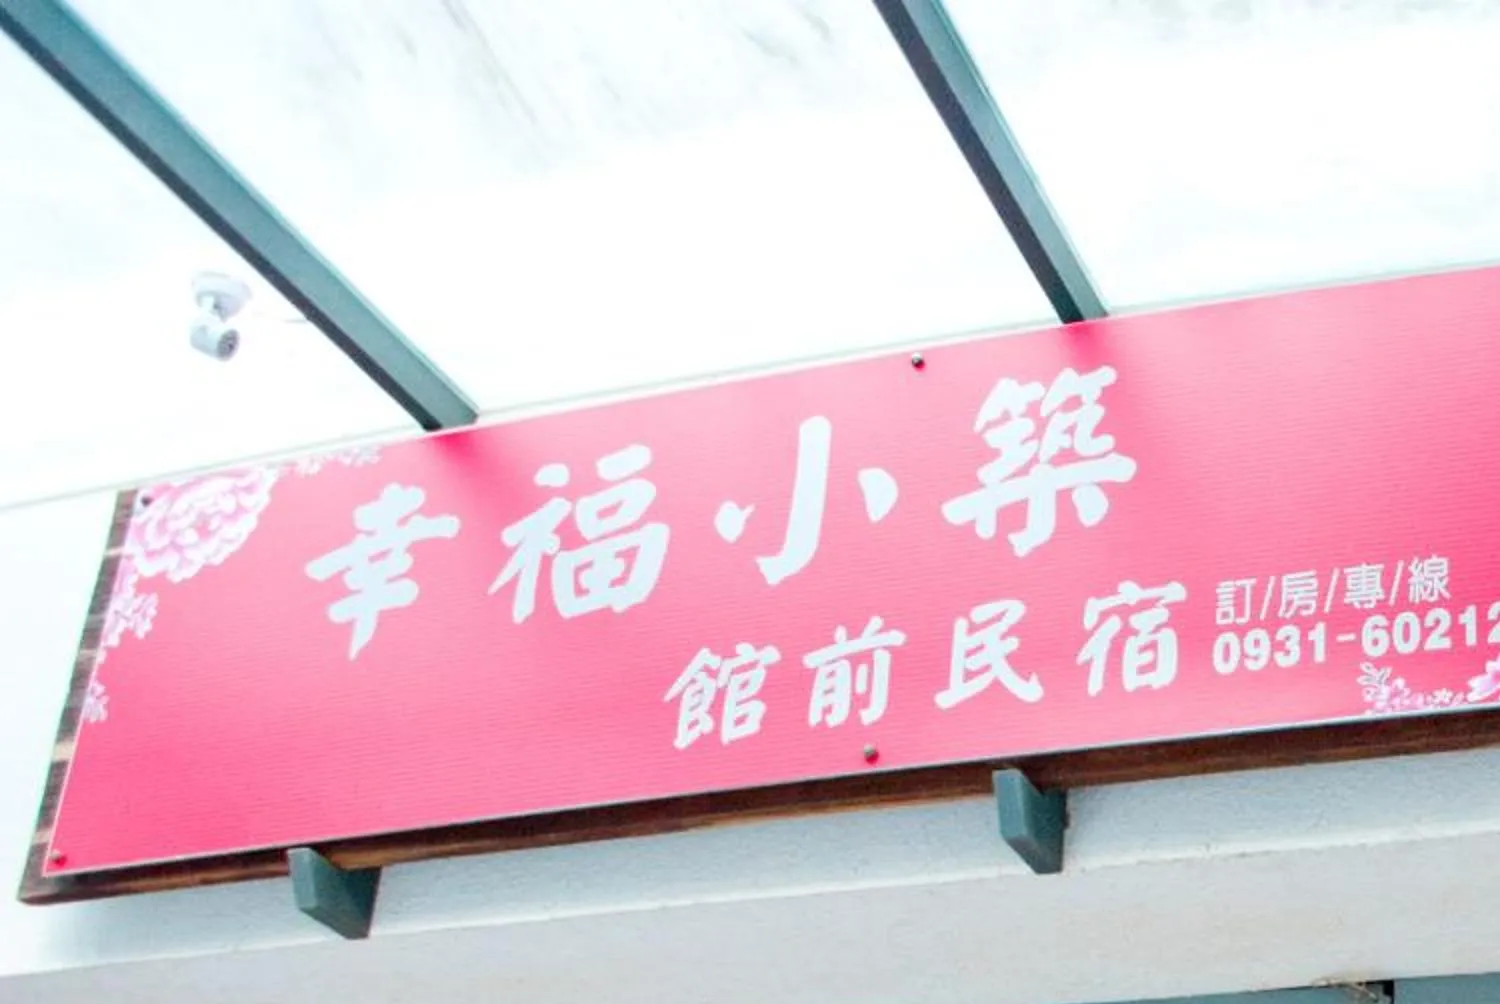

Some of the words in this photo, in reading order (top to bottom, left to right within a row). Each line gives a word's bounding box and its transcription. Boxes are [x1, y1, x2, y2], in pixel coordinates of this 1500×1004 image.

[304, 366, 1138, 660] 幸福小築
[1215, 556, 1451, 626] 訂/房/專/線
[665, 581, 1187, 749] 館前民宿
